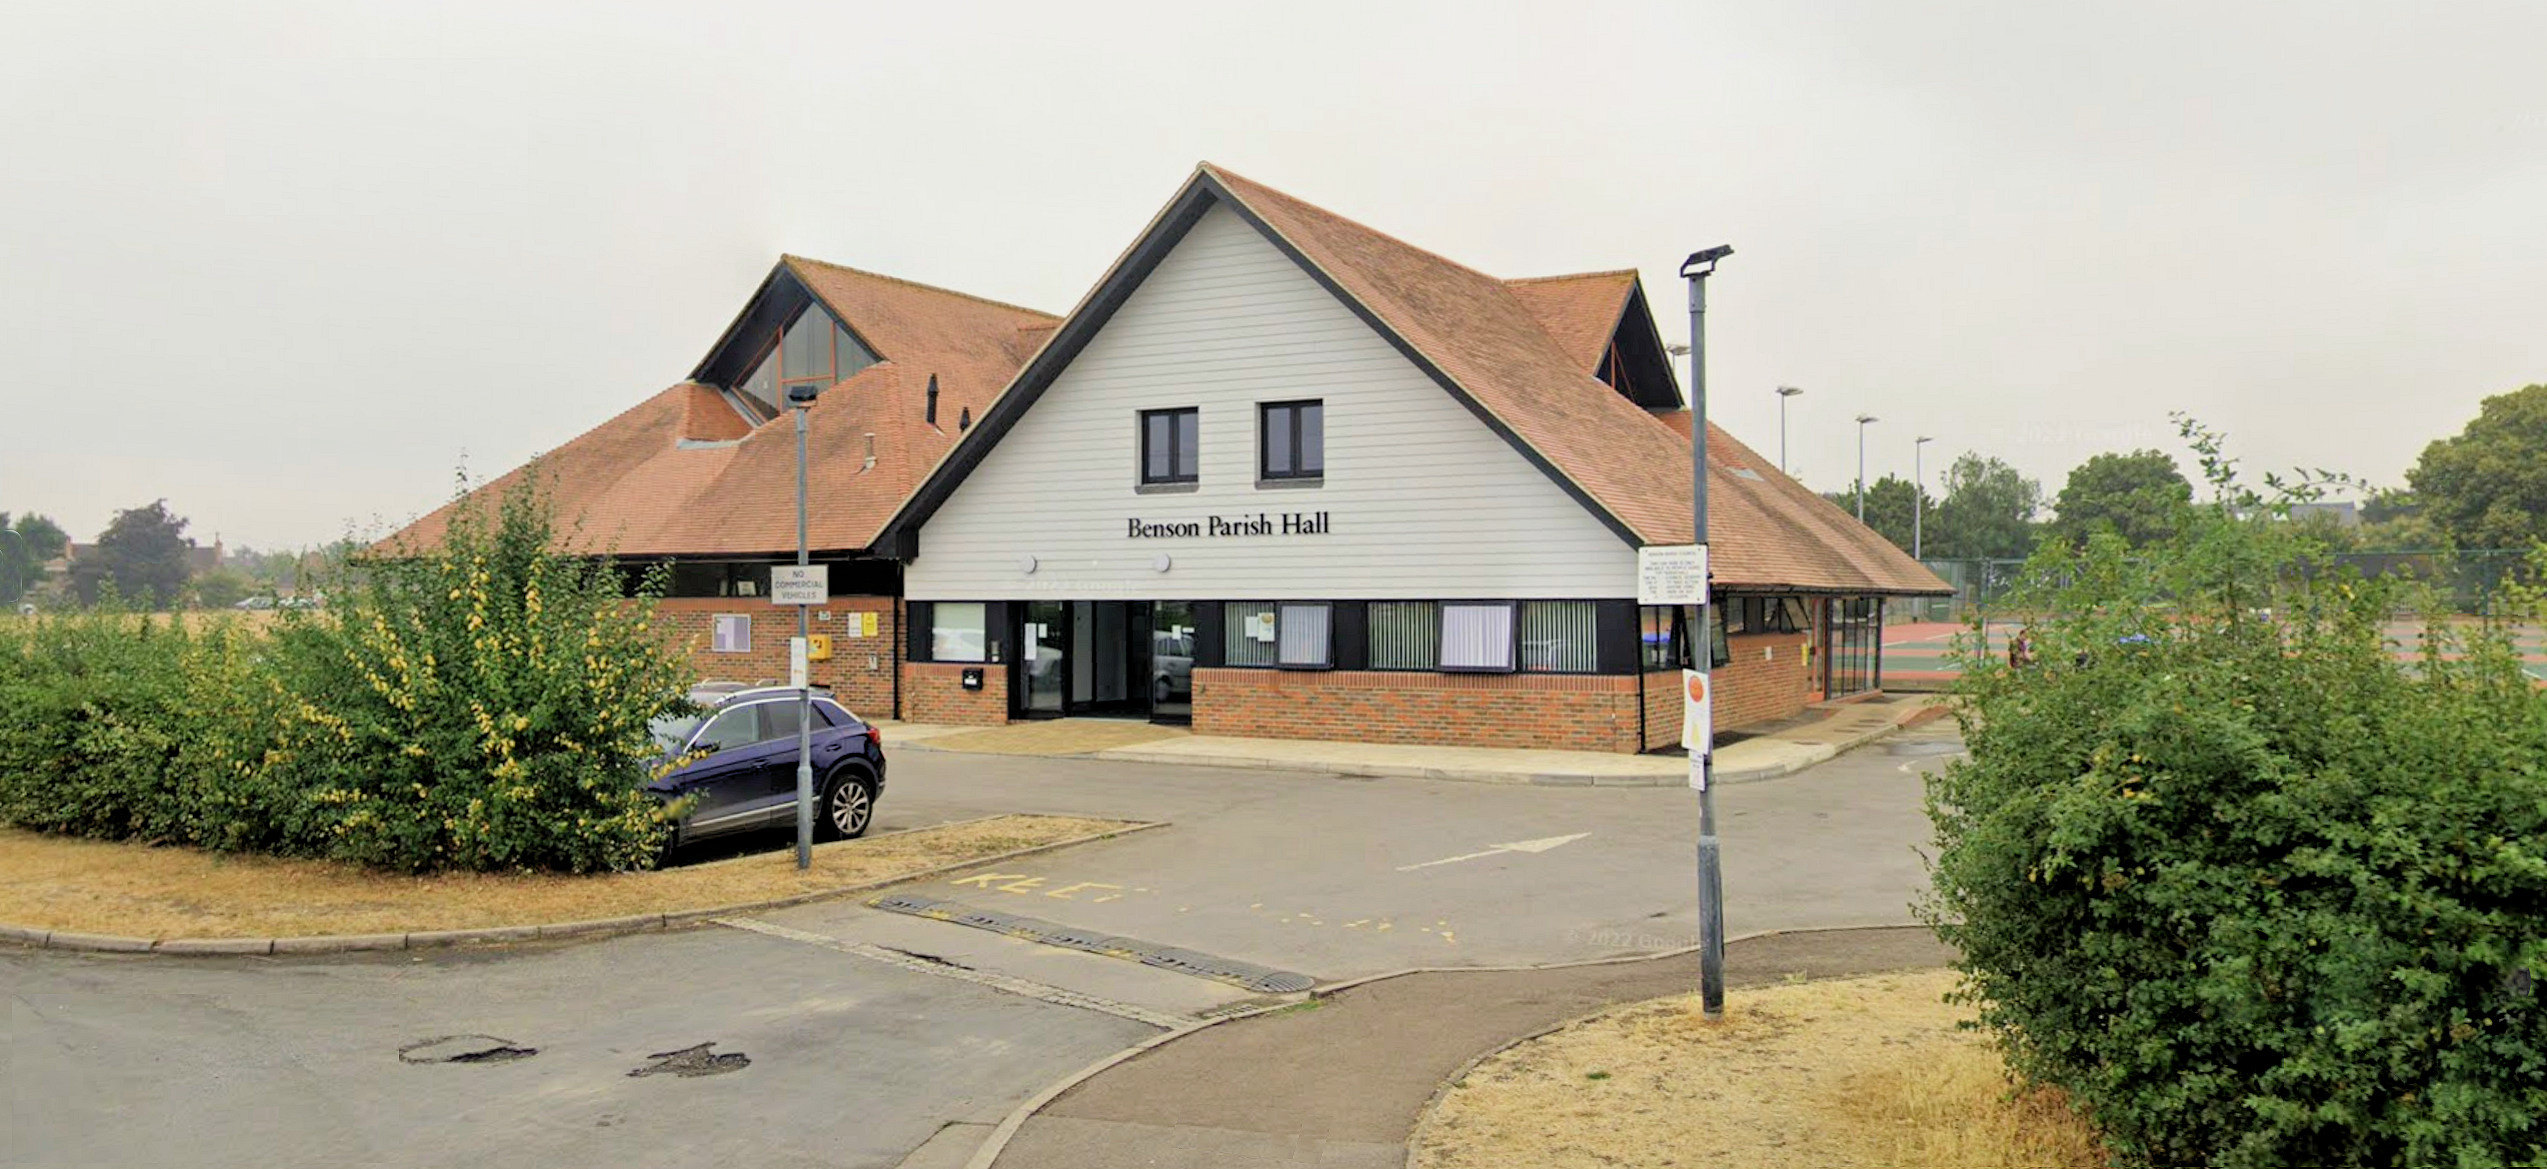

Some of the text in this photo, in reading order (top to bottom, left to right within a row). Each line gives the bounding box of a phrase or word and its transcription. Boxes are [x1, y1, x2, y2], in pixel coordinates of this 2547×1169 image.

[1127, 511, 1329, 538] Benson Parish Hall
[792, 570, 805, 578] NO
[775, 580, 823, 589] COMMERCIAL
[781, 591, 817, 600] VEHICLES
